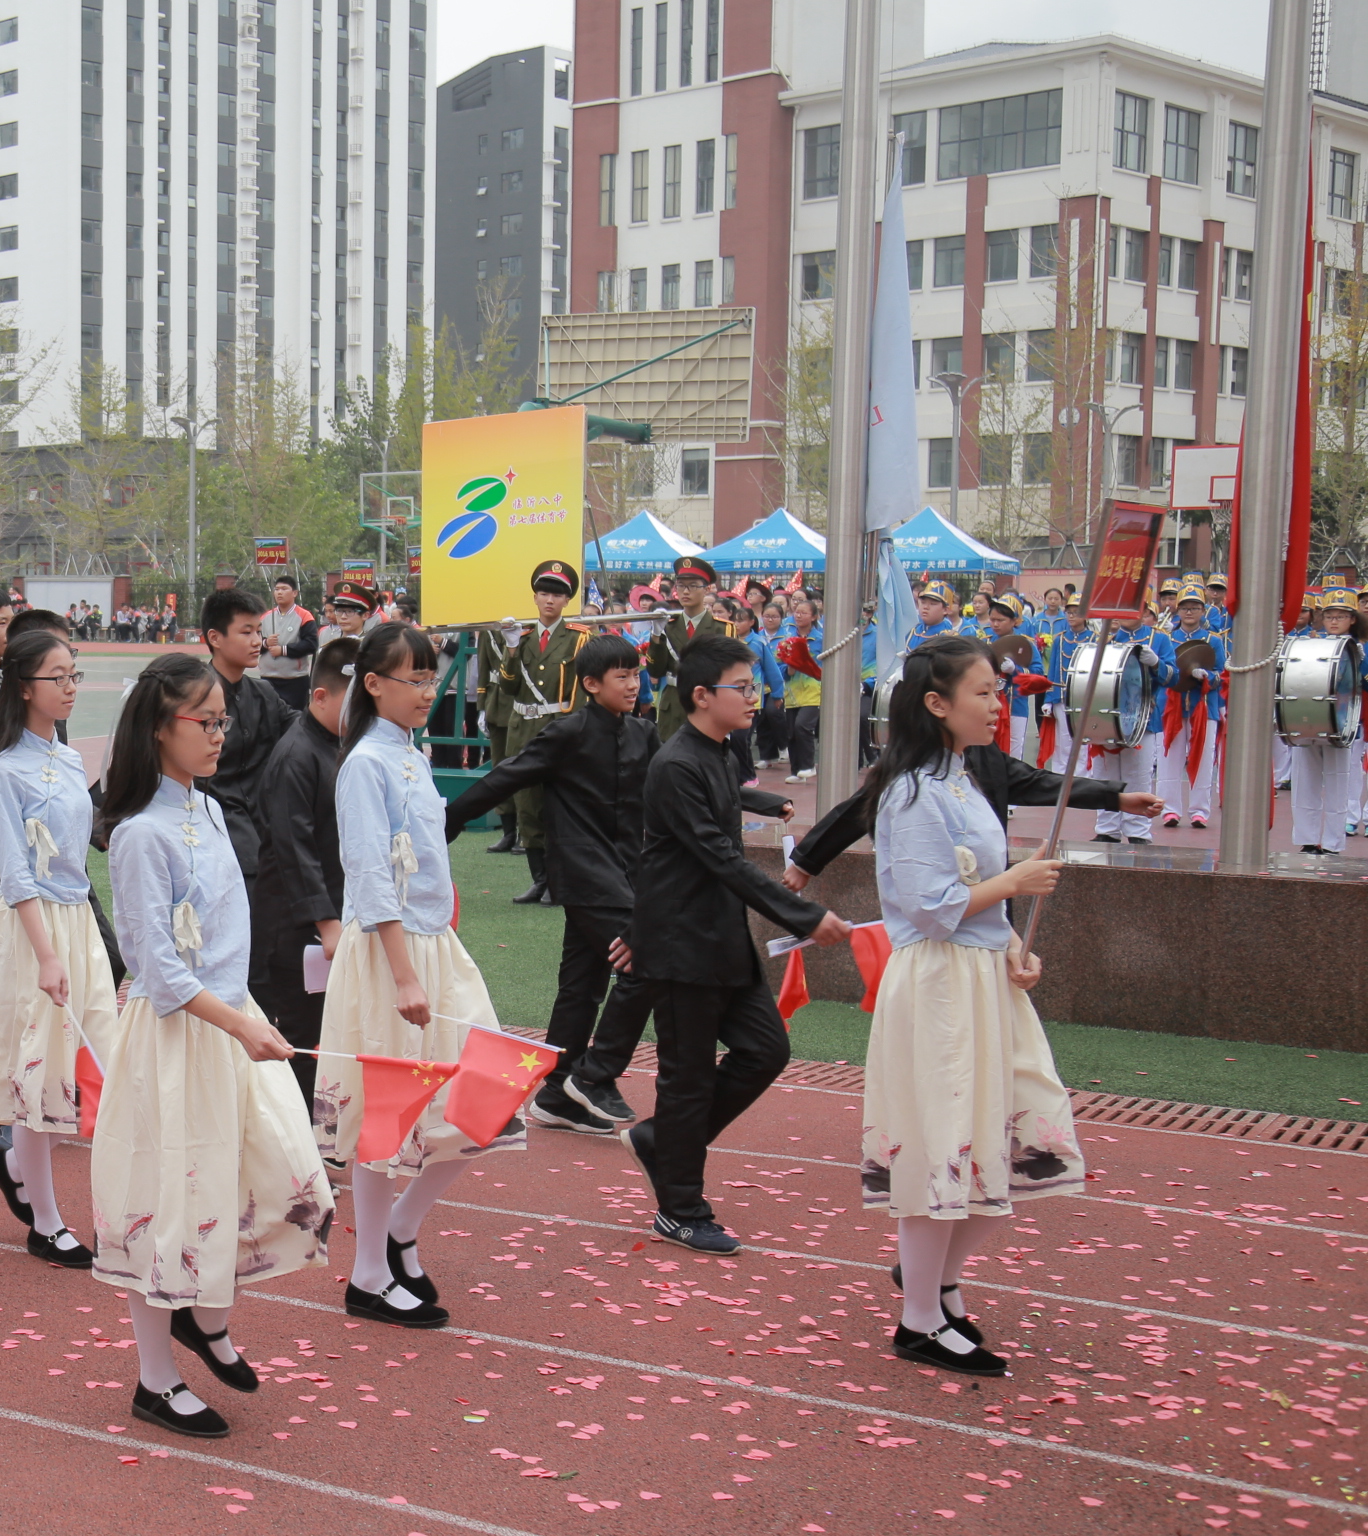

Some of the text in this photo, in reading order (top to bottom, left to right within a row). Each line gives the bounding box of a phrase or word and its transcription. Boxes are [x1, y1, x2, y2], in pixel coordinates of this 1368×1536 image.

[513, 493, 563, 510] 临沂八中
[509, 509, 567, 527] 第七届体育节
